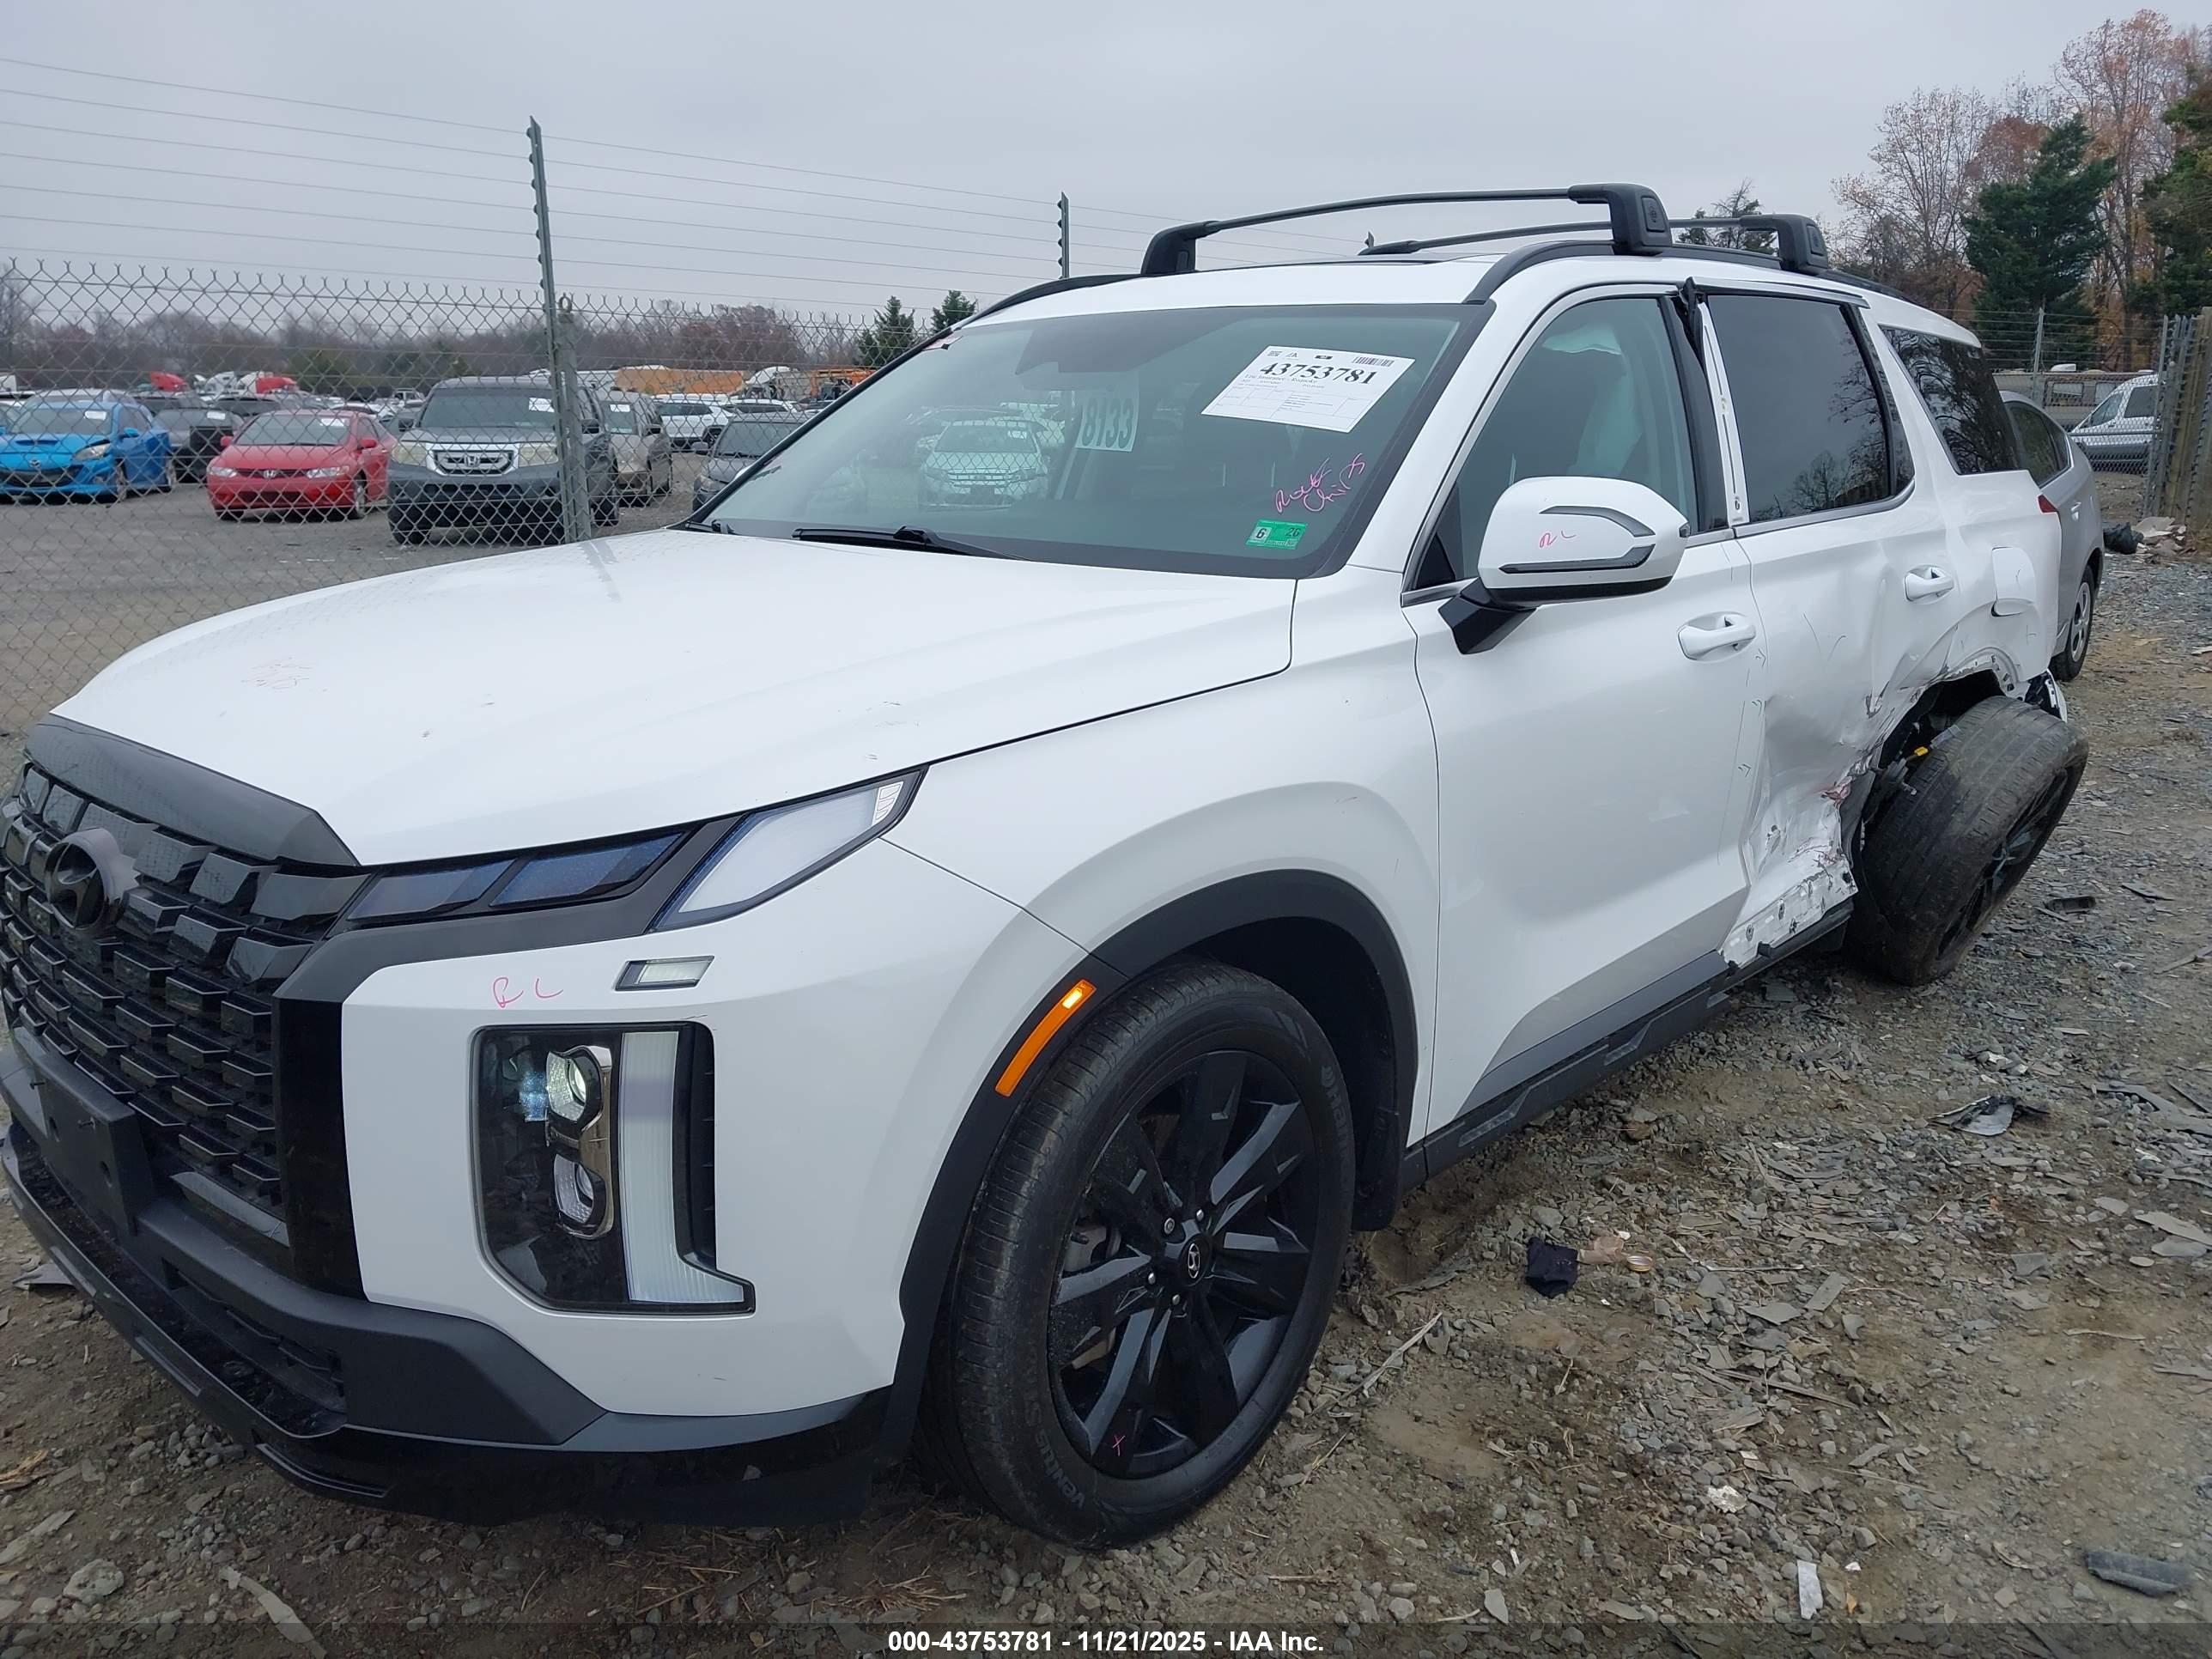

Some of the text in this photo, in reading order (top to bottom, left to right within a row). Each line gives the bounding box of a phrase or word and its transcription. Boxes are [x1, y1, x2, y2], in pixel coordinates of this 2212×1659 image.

[1260, 362, 1377, 386] 43753781
[1081, 397, 1134, 448] 8133
[1255, 527, 1267, 539] 6
[1285, 527, 1302, 538] 26
